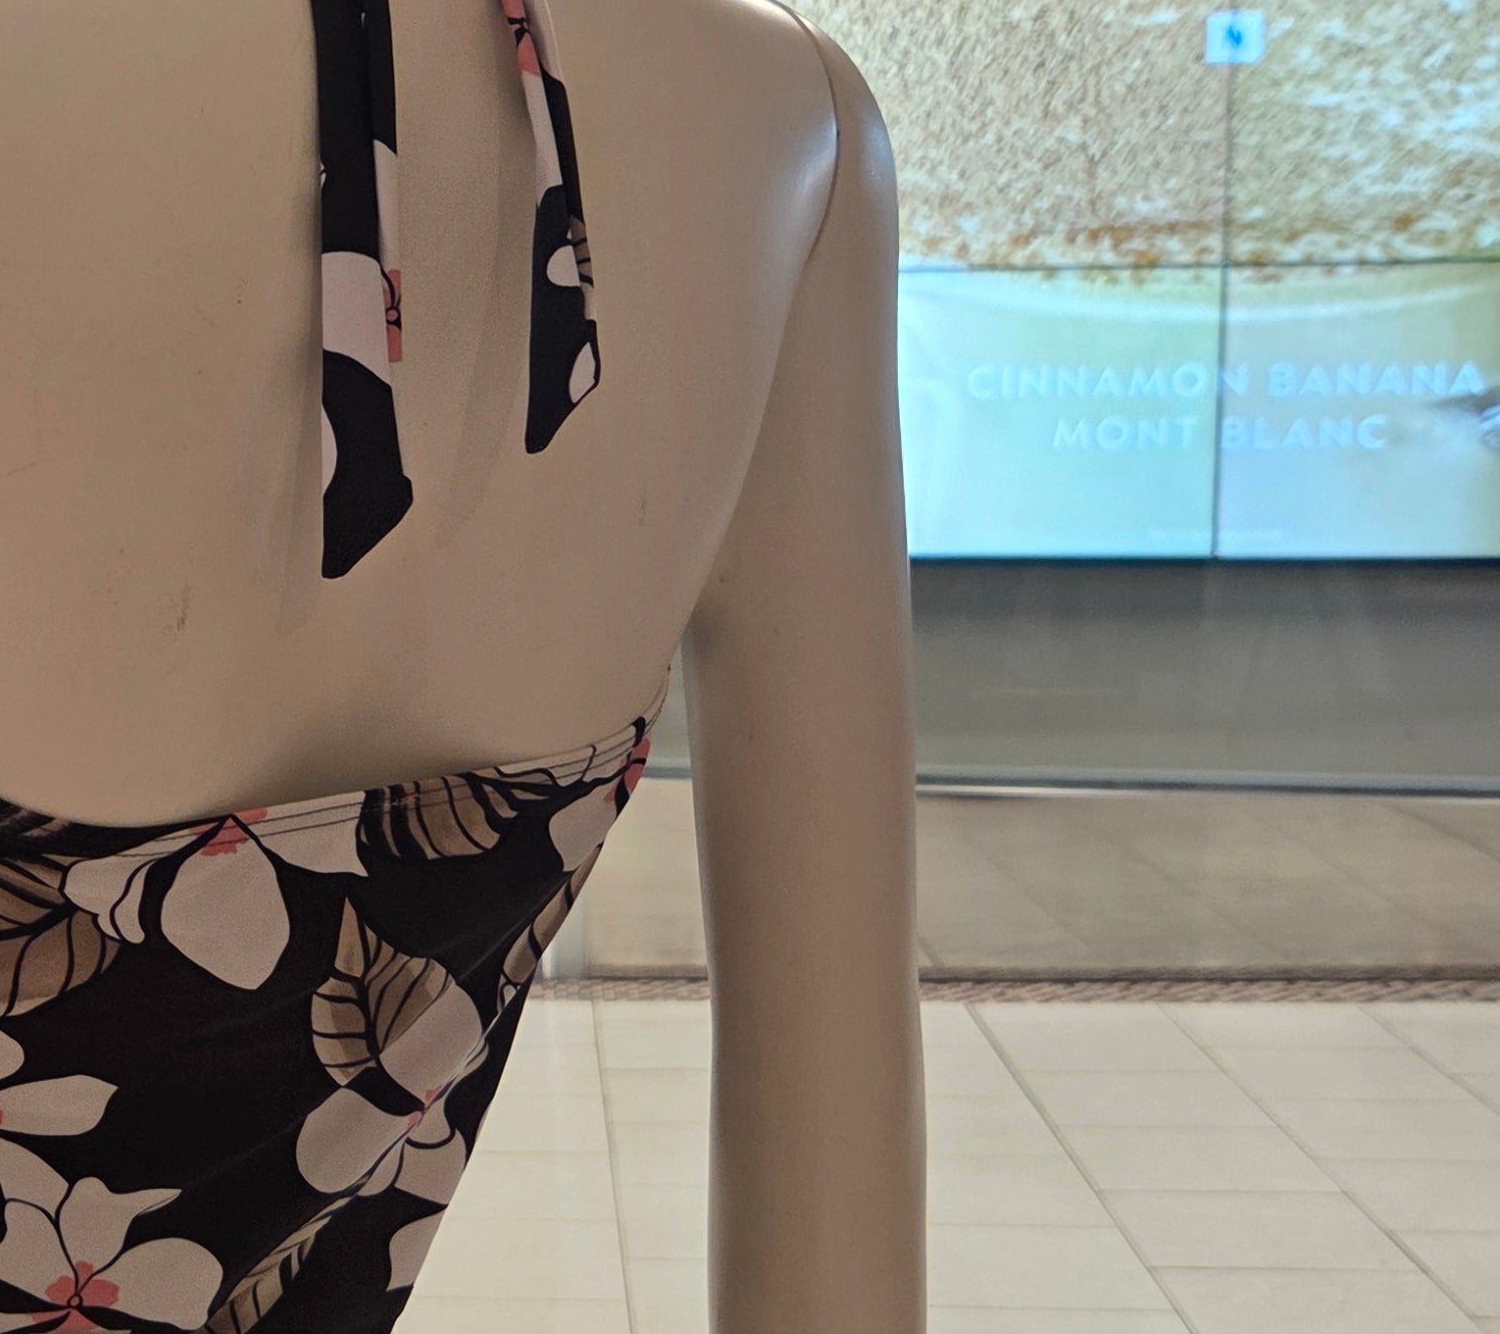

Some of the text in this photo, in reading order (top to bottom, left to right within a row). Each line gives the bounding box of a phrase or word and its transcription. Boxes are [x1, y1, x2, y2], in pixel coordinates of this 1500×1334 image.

[967, 360, 1485, 399] CINNAMON BANANA
[1052, 414, 1388, 451] MONT BLANC
